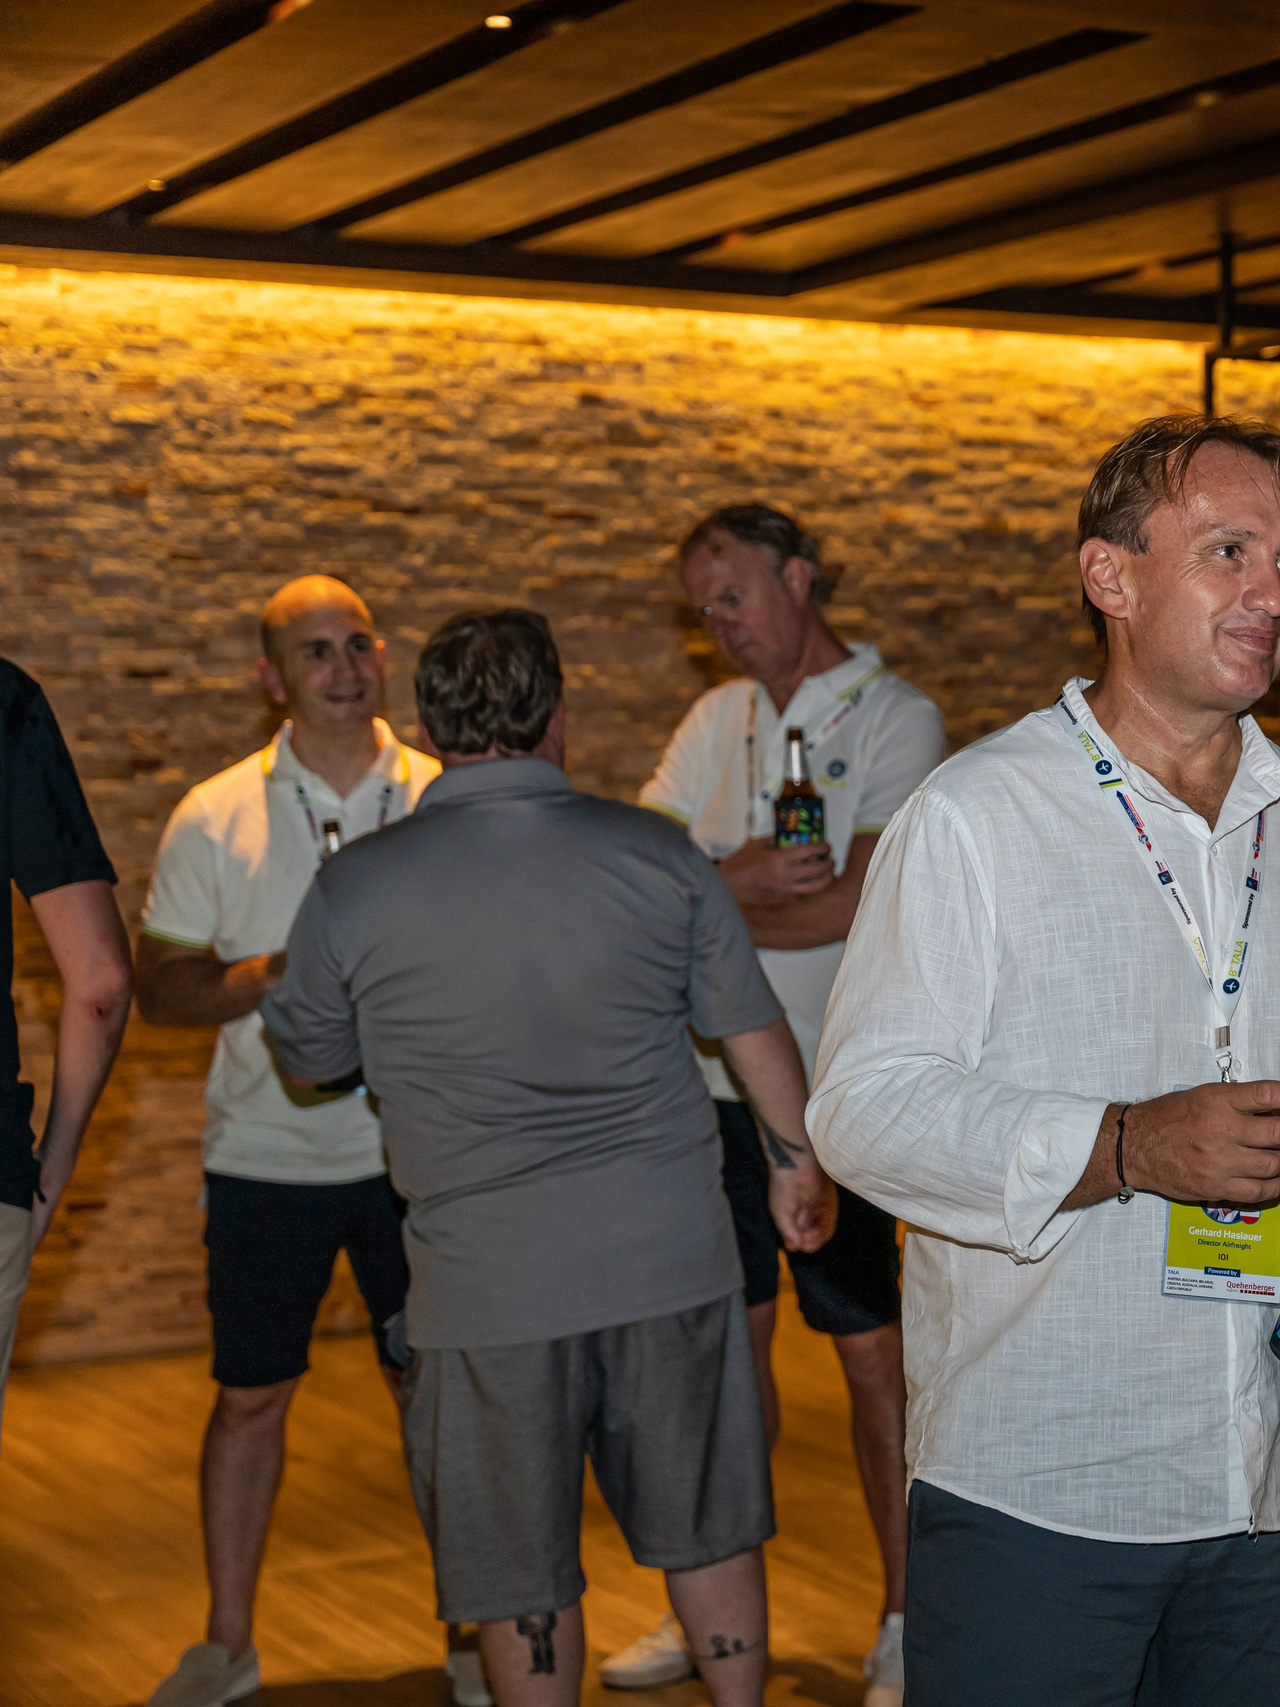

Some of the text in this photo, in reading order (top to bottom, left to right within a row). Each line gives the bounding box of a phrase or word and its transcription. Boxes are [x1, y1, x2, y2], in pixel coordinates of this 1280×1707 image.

[1060, 700, 1078, 725] Sponsored by
[1077, 731, 1094, 753] TALA
[1170, 887, 1192, 925] Sponsored by
[1242, 892, 1256, 930] Sponsored by
[1231, 941, 1245, 964] TALA
[1188, 1226, 1262, 1242] Gerhard Haslauer
[1197, 1238, 1252, 1250] Director Airfreight
[1207, 1267, 1230, 1275] Powered
[1226, 1280, 1275, 1292] Quehenberger
